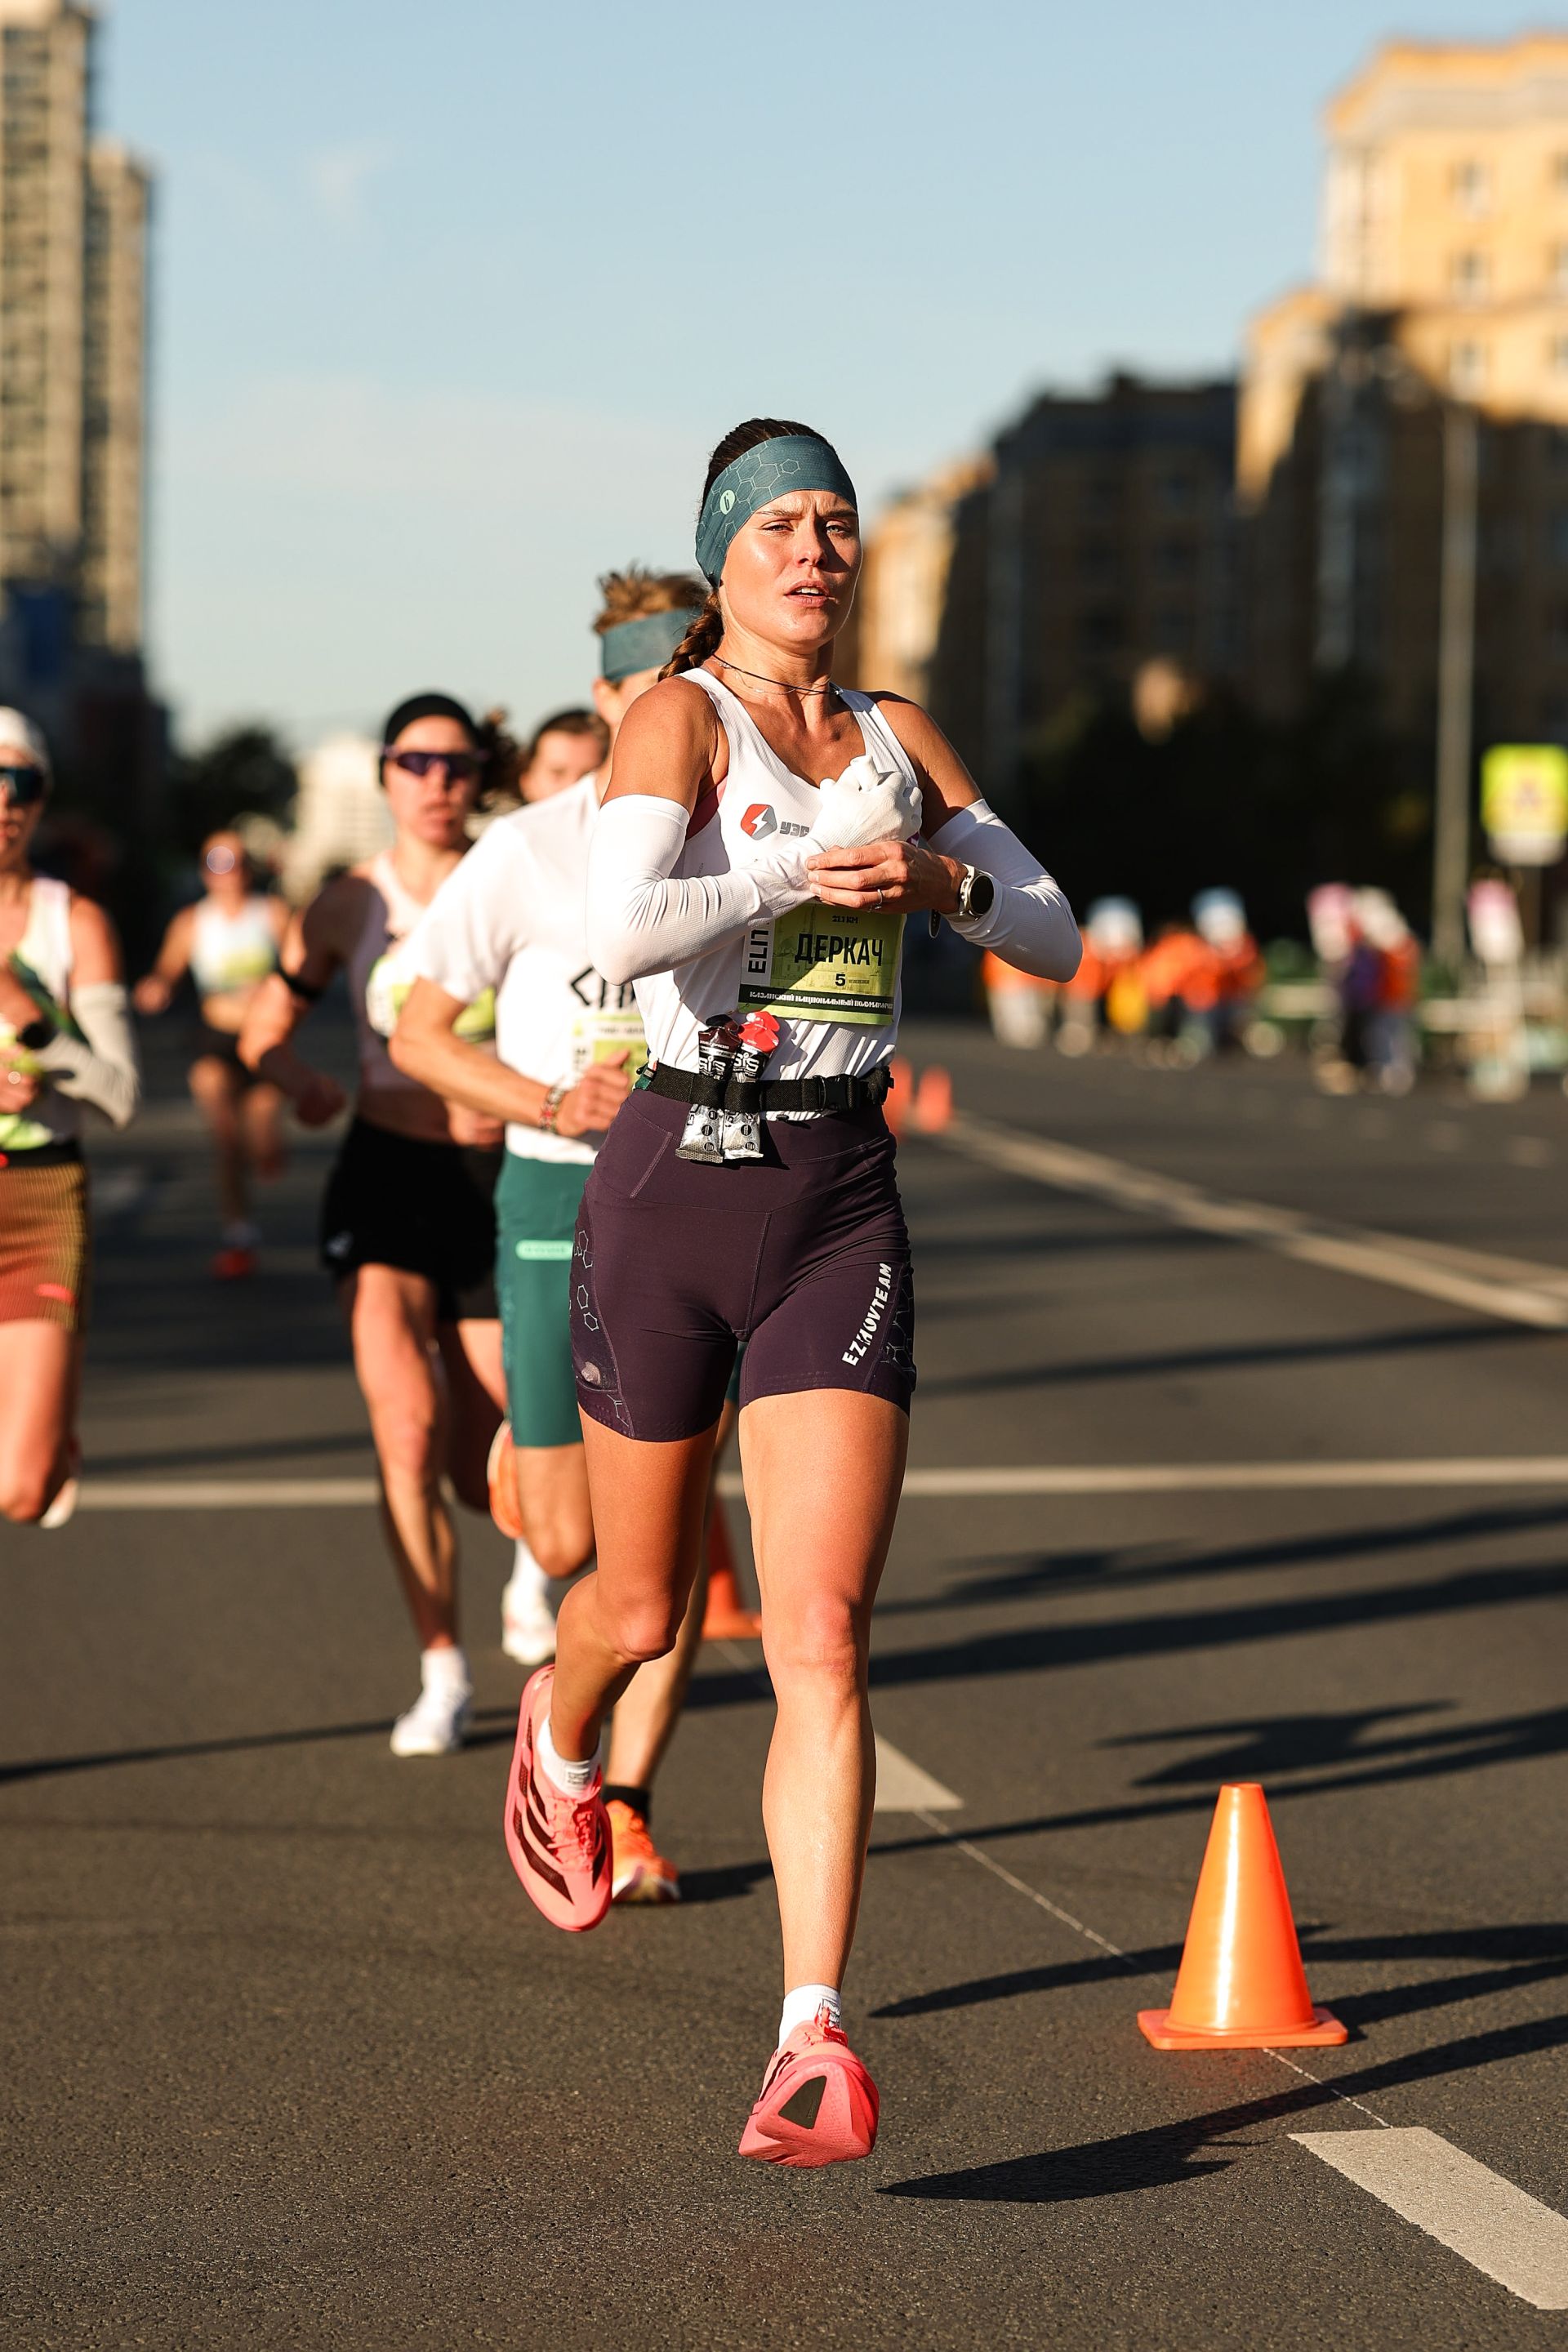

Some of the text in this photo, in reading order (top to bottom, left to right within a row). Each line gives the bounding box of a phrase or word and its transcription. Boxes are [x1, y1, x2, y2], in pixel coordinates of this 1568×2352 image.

[747, 922, 769, 973] ELIT
[795, 933, 883, 967] ДЕРКАЧ
[835, 973, 846, 987] 5
[749, 991, 795, 1001] КАЗАНСКИЙ
